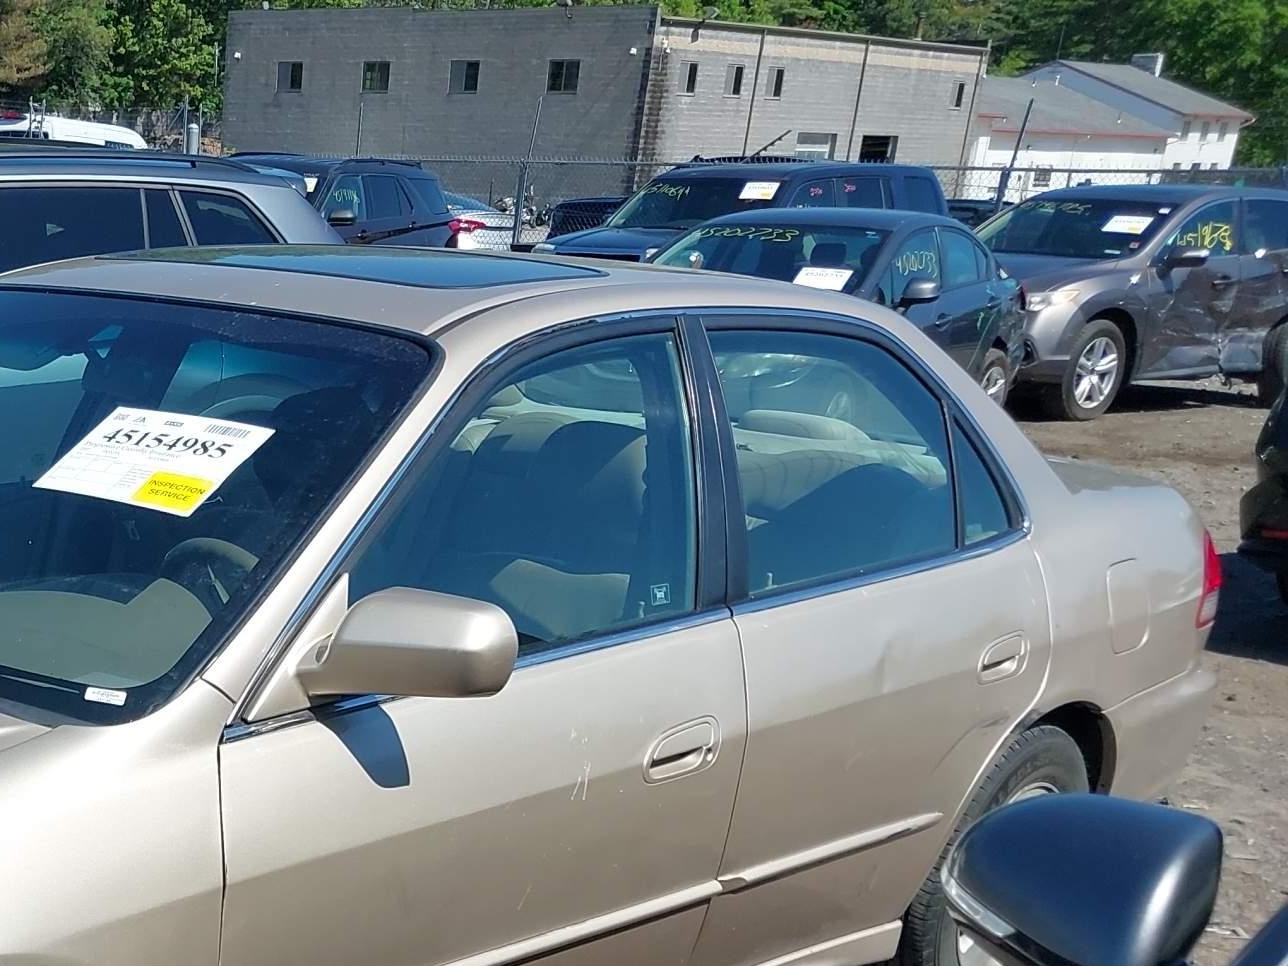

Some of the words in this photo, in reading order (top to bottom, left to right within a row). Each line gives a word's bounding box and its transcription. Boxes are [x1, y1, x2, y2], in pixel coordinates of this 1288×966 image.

[103, 427, 235, 459] 45154985
[148, 488, 191, 501] SERVICE
[149, 479, 206, 495] INSPECTION
